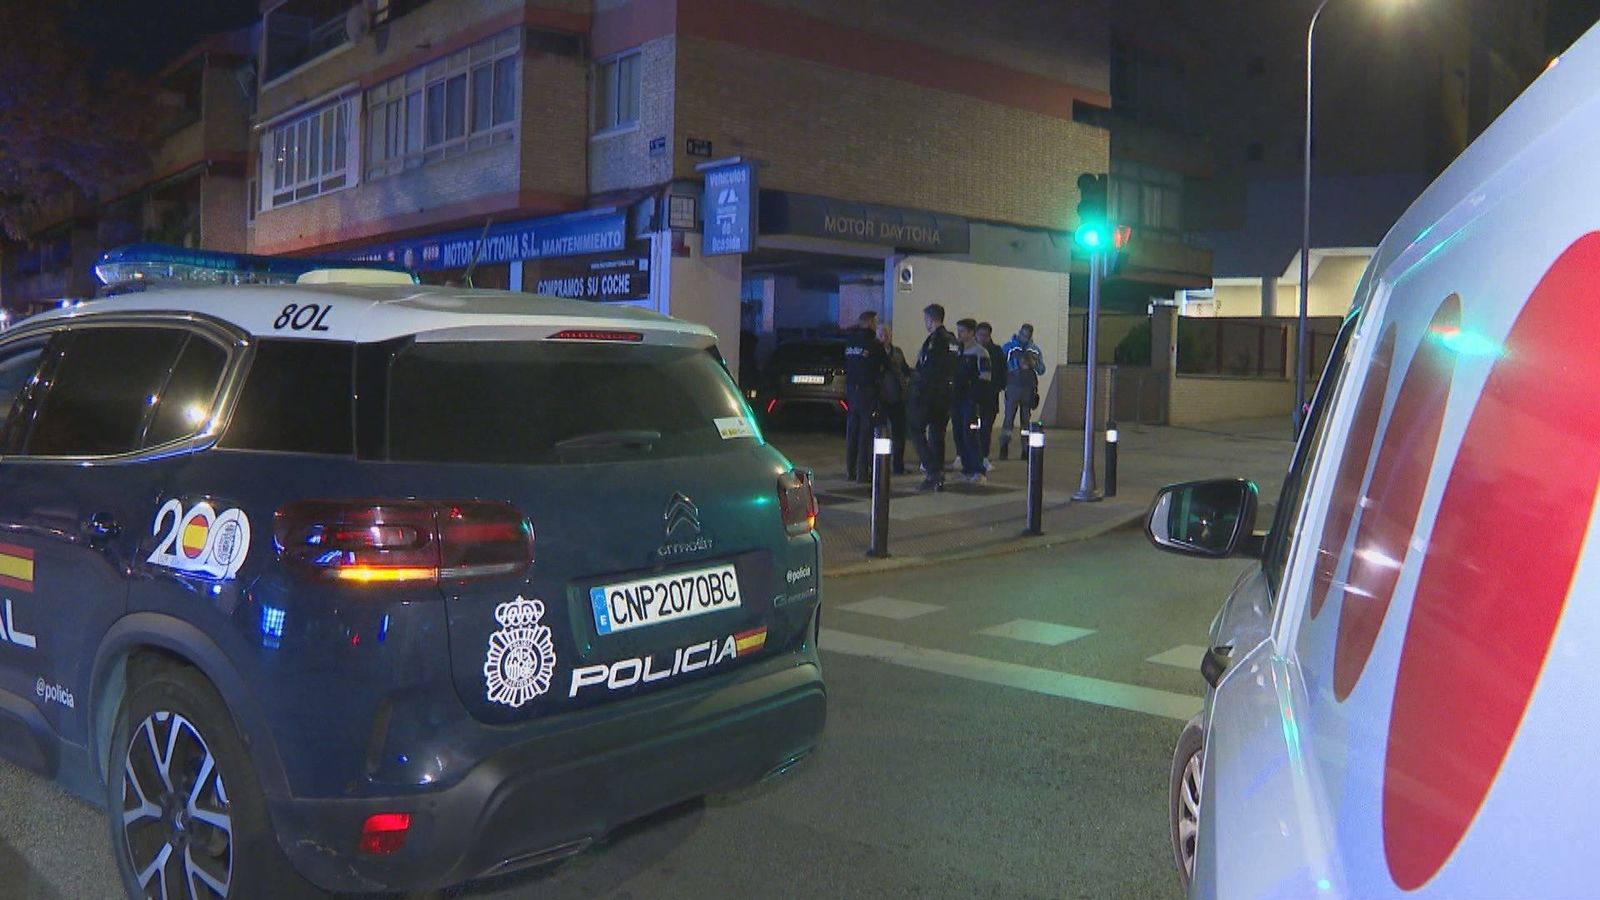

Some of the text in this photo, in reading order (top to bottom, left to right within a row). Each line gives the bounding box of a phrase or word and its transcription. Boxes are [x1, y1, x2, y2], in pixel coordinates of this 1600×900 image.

[824, 215, 941, 245] MOTOR DAYTONA
[443, 231, 621, 267] MOTOR DAYTONA S.L. MANTENIMIENTO
[538, 274, 631, 298] COMPRAMOS SU COCHE
[146, 498, 251, 579] 200
[600, 616, 608, 626] E
[611, 571, 737, 624] CNP2070BC
[36, 677, 75, 708] @policia
